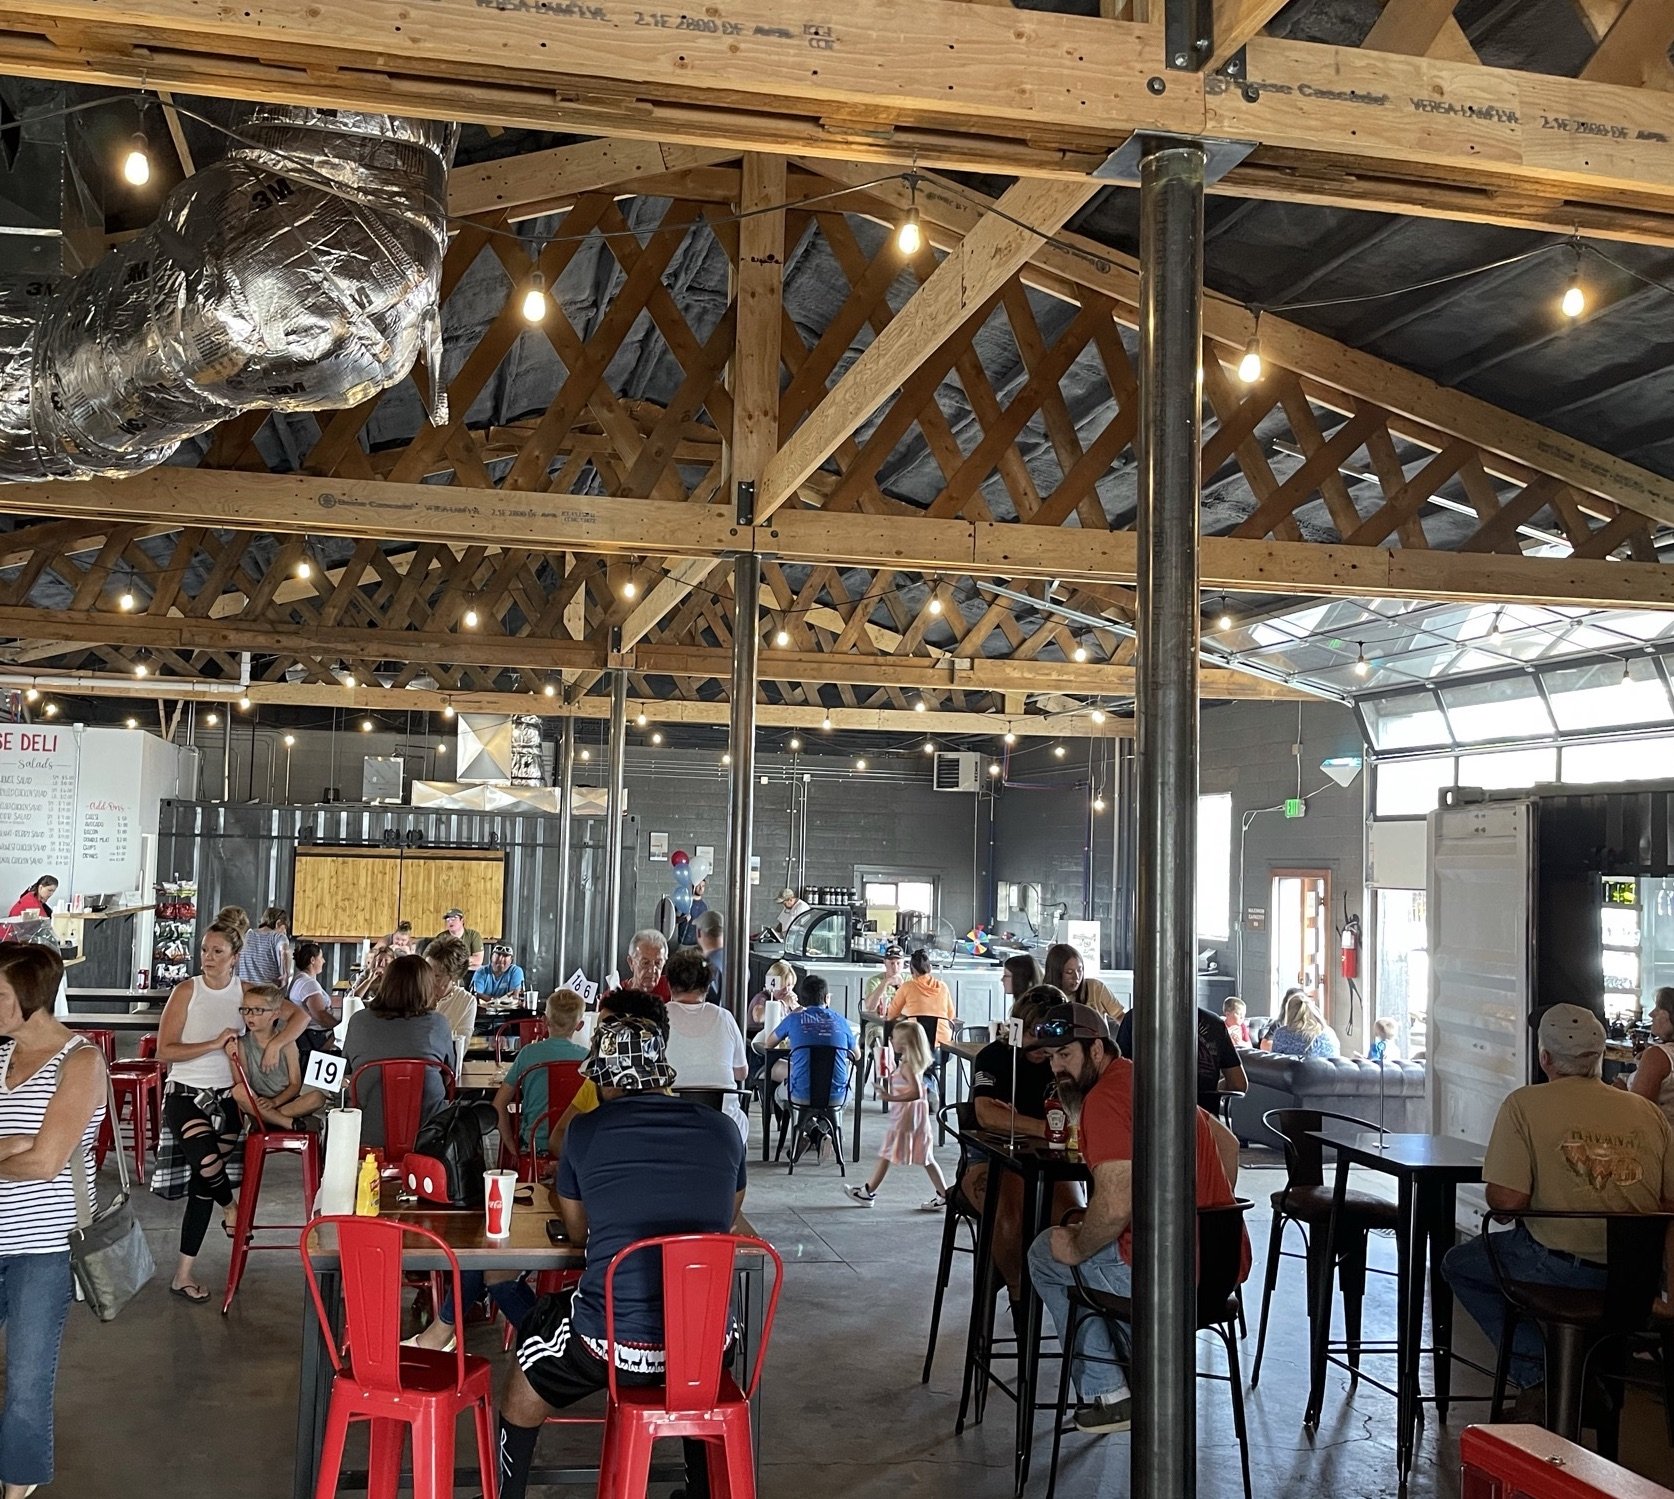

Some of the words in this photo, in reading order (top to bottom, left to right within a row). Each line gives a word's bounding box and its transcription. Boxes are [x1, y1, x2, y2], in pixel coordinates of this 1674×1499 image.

[721, 20, 745, 35] DF
[251, 177, 294, 211] 3M
[20, 732, 58, 753] DELI
[17, 756, 54, 770] Salads
[770, 978, 776, 988] 4
[583, 984, 592, 999] 6
[314, 1058, 338, 1085] 19
